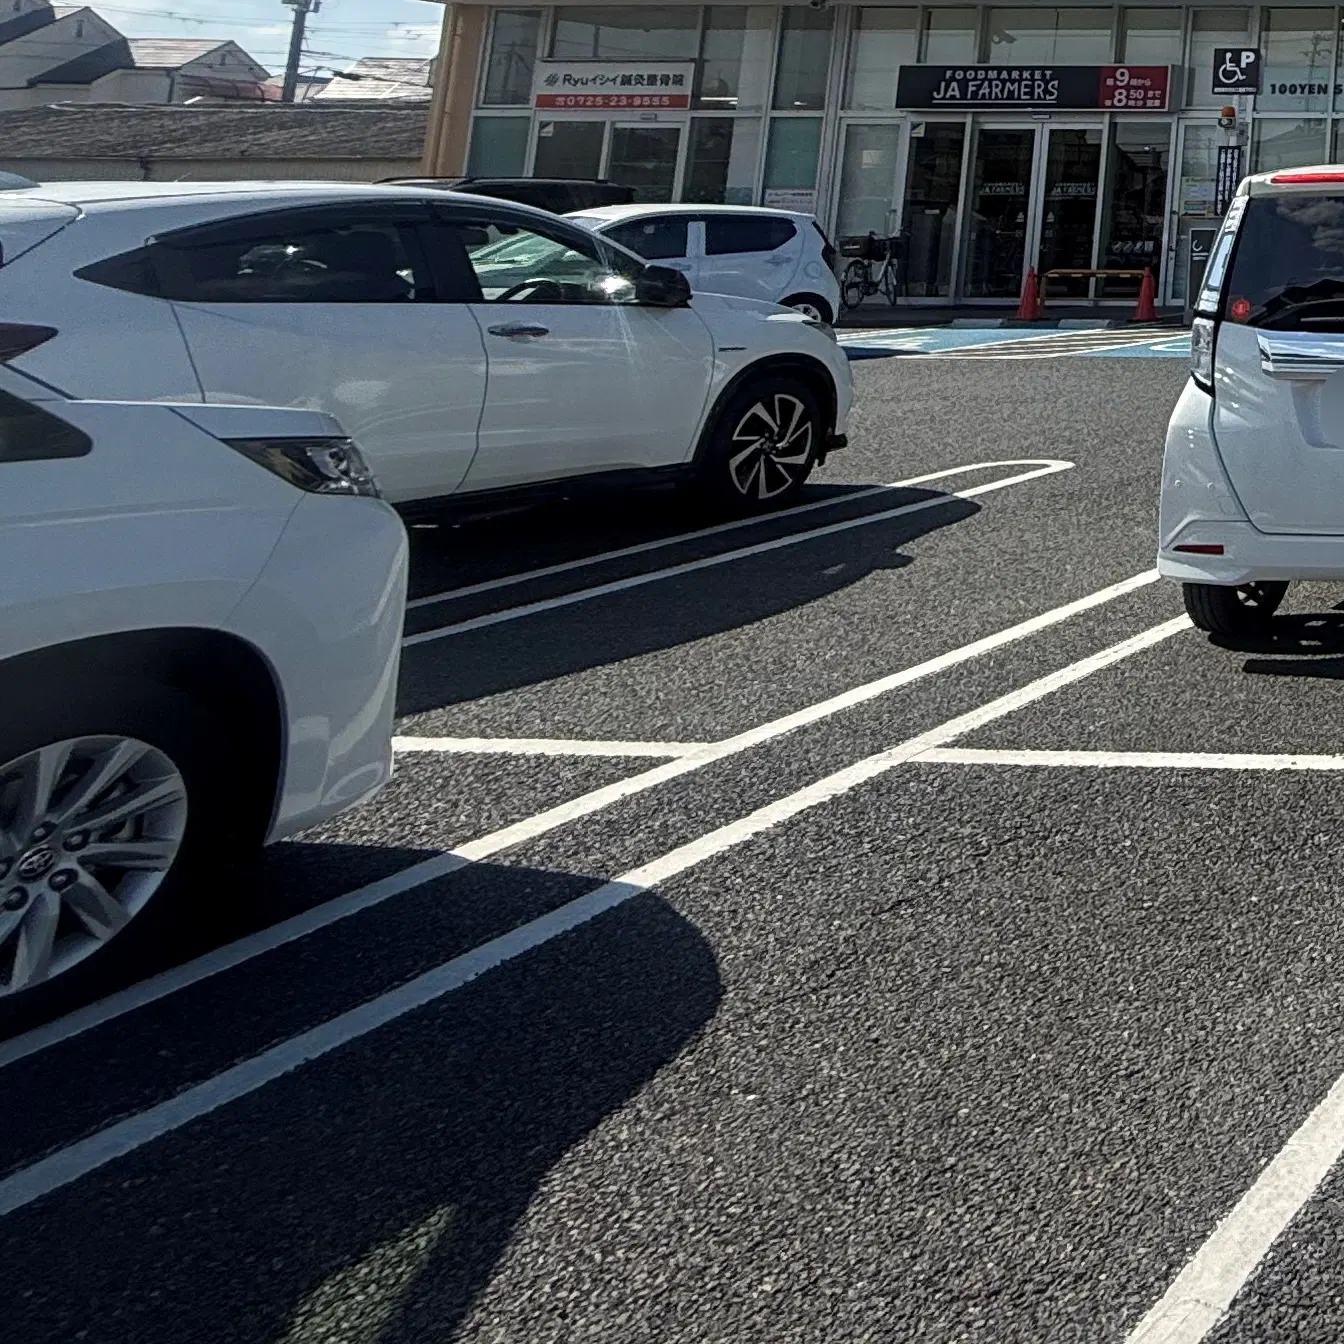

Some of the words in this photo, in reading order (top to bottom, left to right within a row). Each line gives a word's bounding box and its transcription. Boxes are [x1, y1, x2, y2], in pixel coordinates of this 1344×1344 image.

[1240, 51, 1255, 68] P
[933, 81, 960, 99] JA
[967, 80, 1059, 101] FARMERS
[1270, 83, 1328, 95] 100YEN
